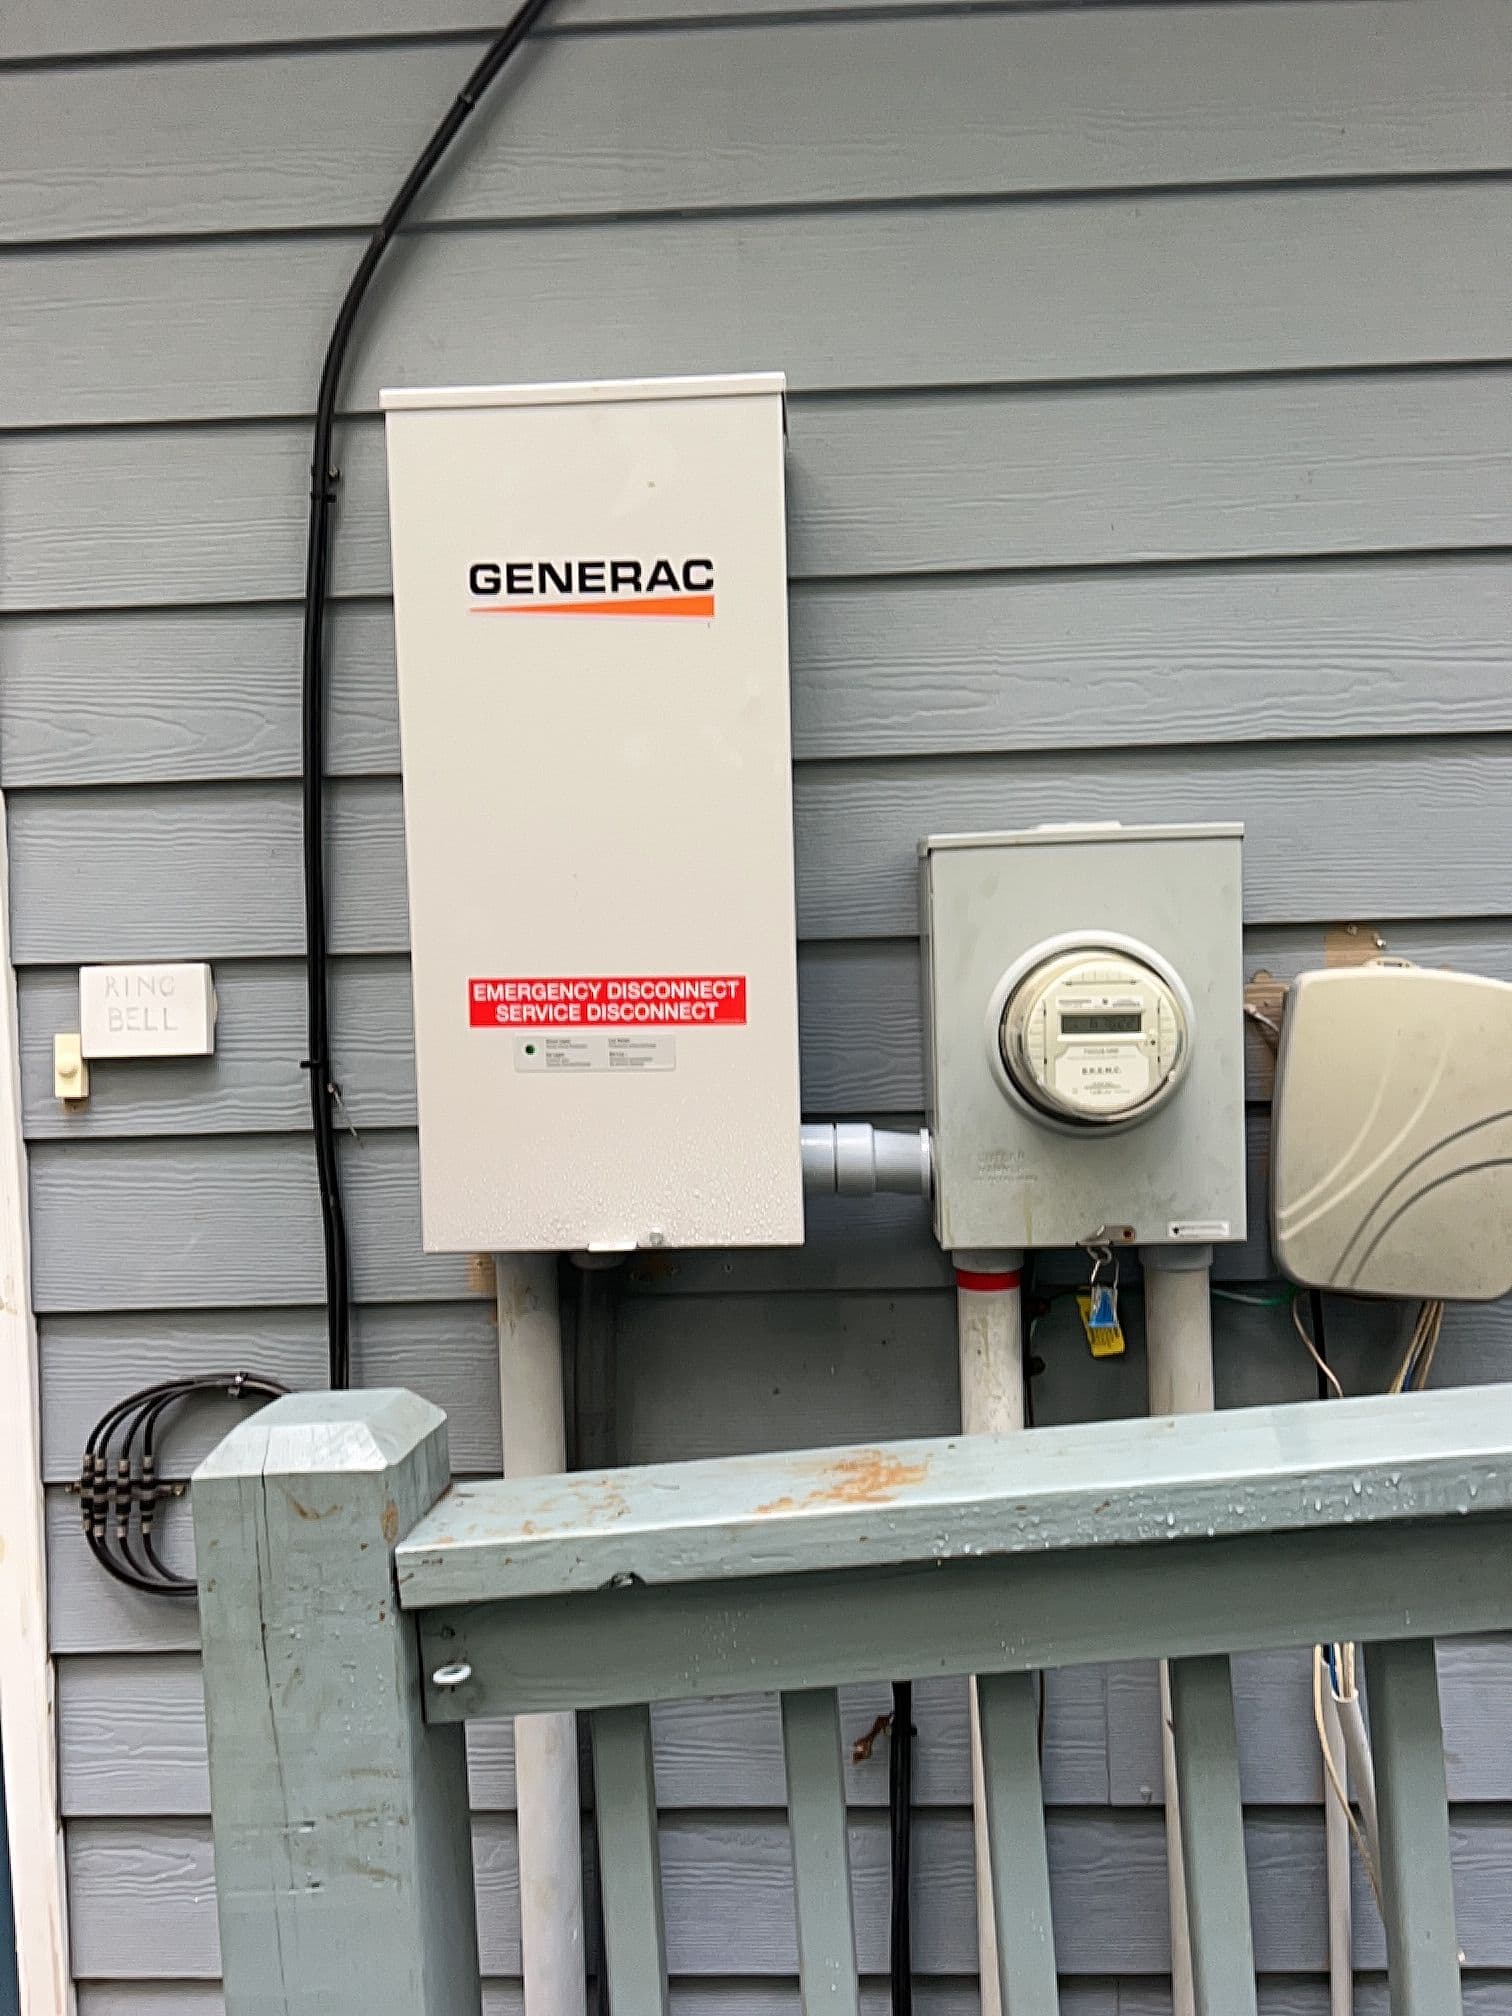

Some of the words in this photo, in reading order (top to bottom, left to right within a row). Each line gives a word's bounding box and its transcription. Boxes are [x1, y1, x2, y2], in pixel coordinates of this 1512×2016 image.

[469, 559, 714, 594] GENERAC
[105, 975, 176, 997] RING
[472, 981, 602, 1002] EMERGENCY
[607, 980, 740, 1001] DISCONNECT
[107, 1006, 179, 1032] BELL
[495, 1003, 582, 1023] SERVICE
[586, 1001, 720, 1022] DISCONNECT
